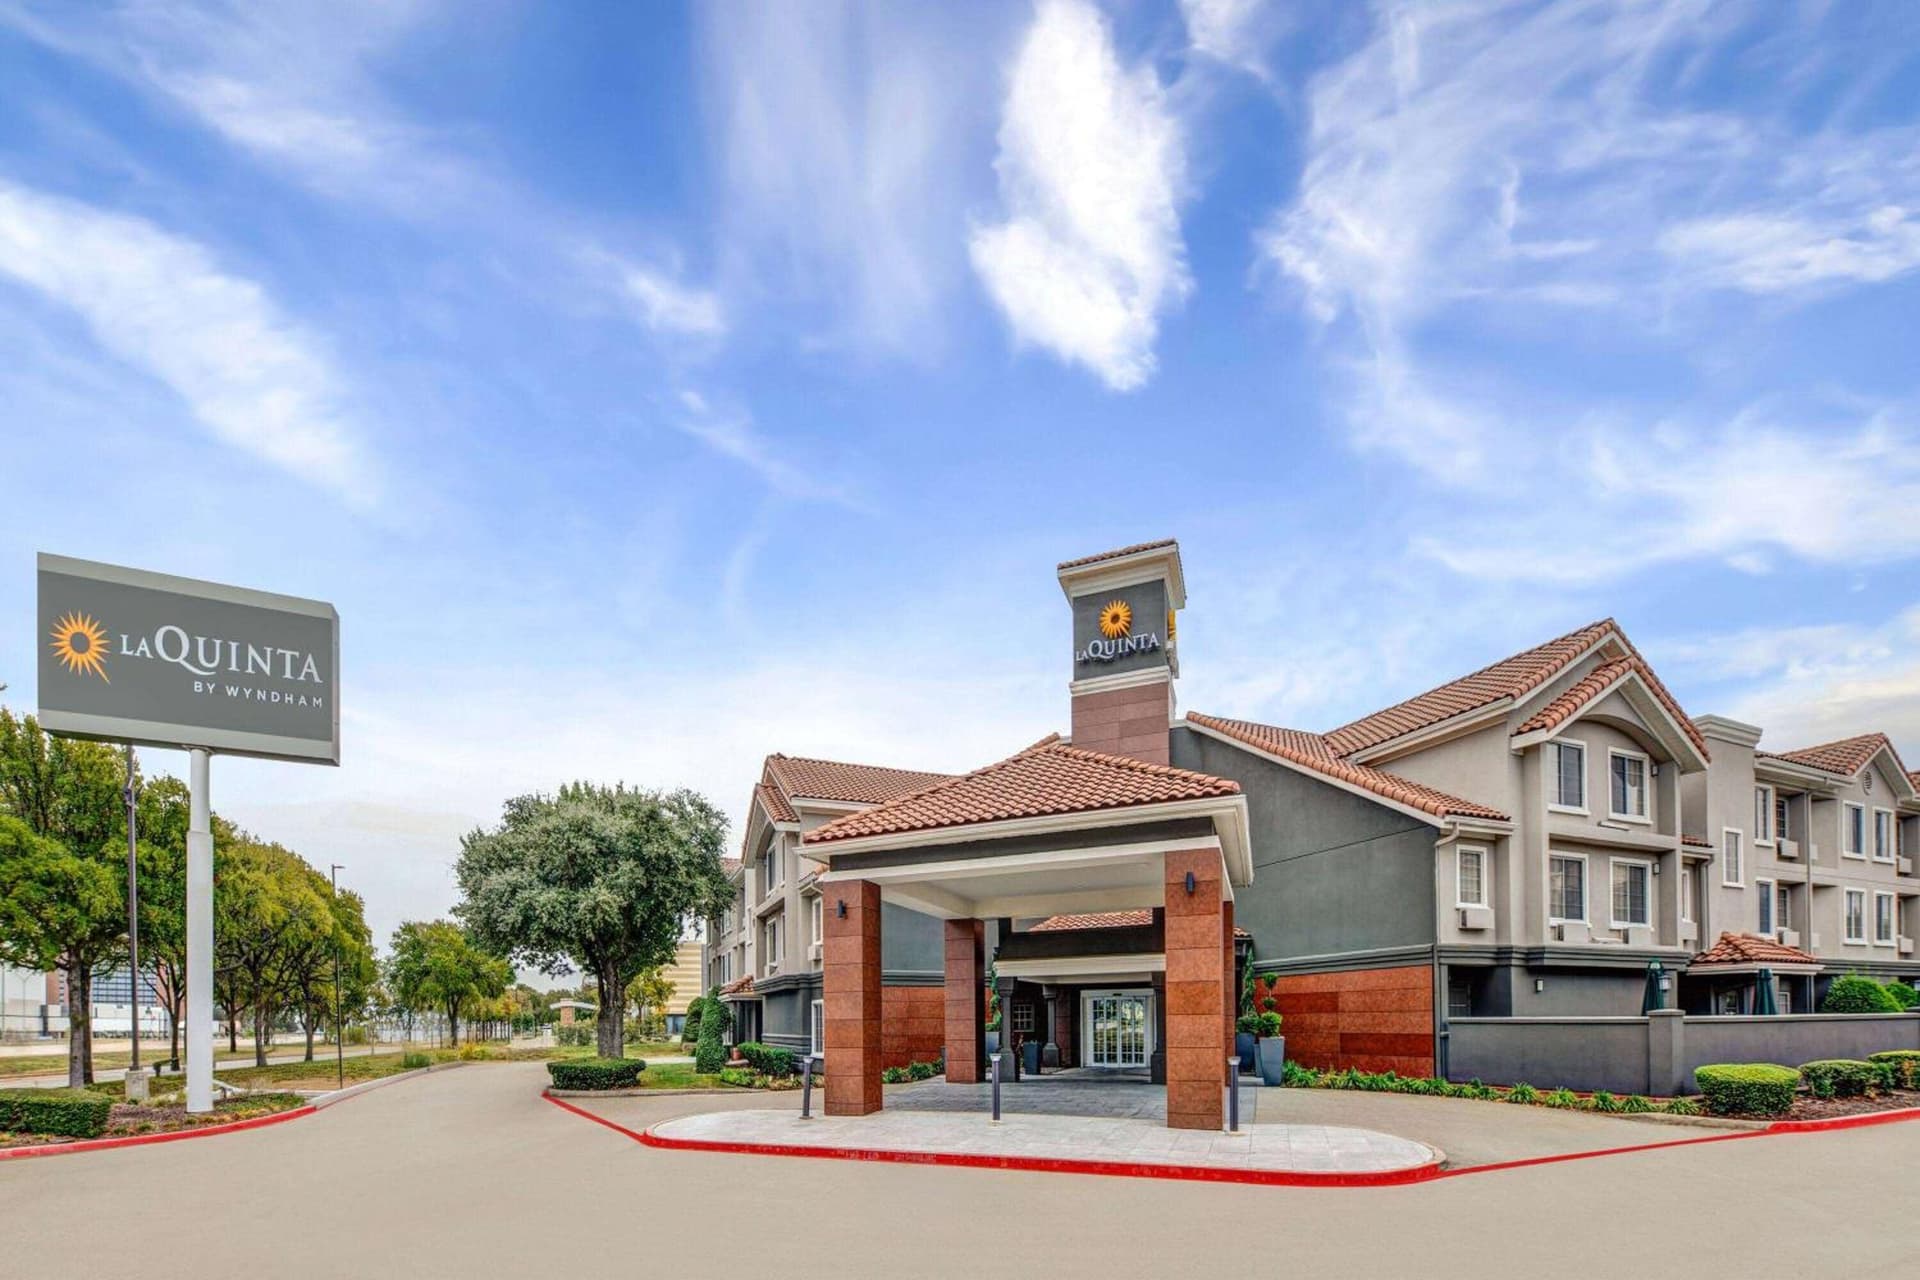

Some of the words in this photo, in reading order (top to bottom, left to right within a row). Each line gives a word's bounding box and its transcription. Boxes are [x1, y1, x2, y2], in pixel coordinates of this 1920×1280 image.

[154, 625, 323, 683] QUINTA
[1089, 633, 1159, 659] QUINTA
[193, 681, 216, 694] BY
[226, 685, 323, 708] WYNDHAM
